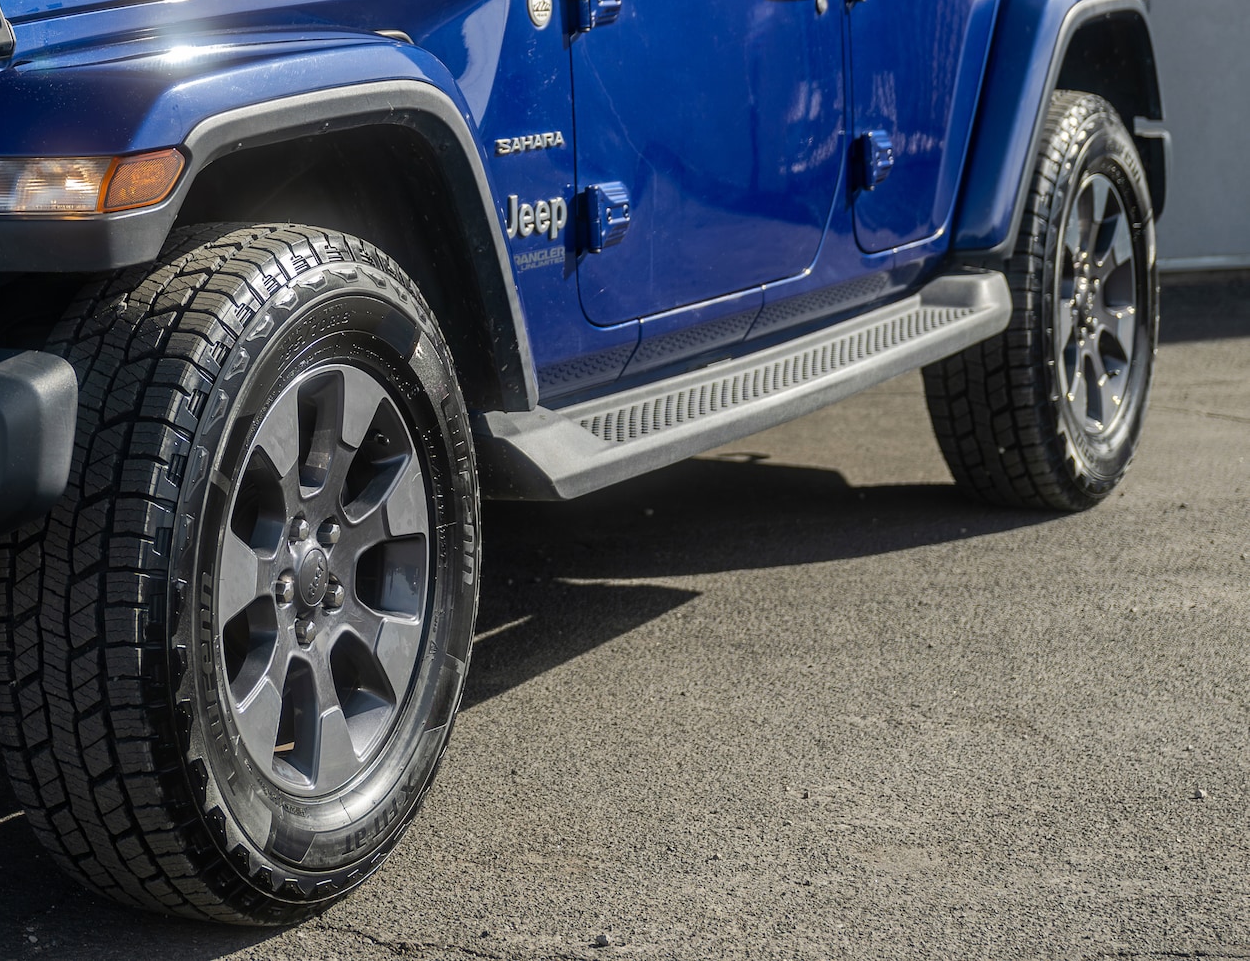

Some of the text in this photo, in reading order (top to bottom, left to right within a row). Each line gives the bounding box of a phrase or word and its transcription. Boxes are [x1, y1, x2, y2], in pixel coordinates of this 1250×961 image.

[495, 131, 564, 155] SAHARA
[507, 194, 568, 239] Jeep
[513, 246, 566, 266] RANGLER
